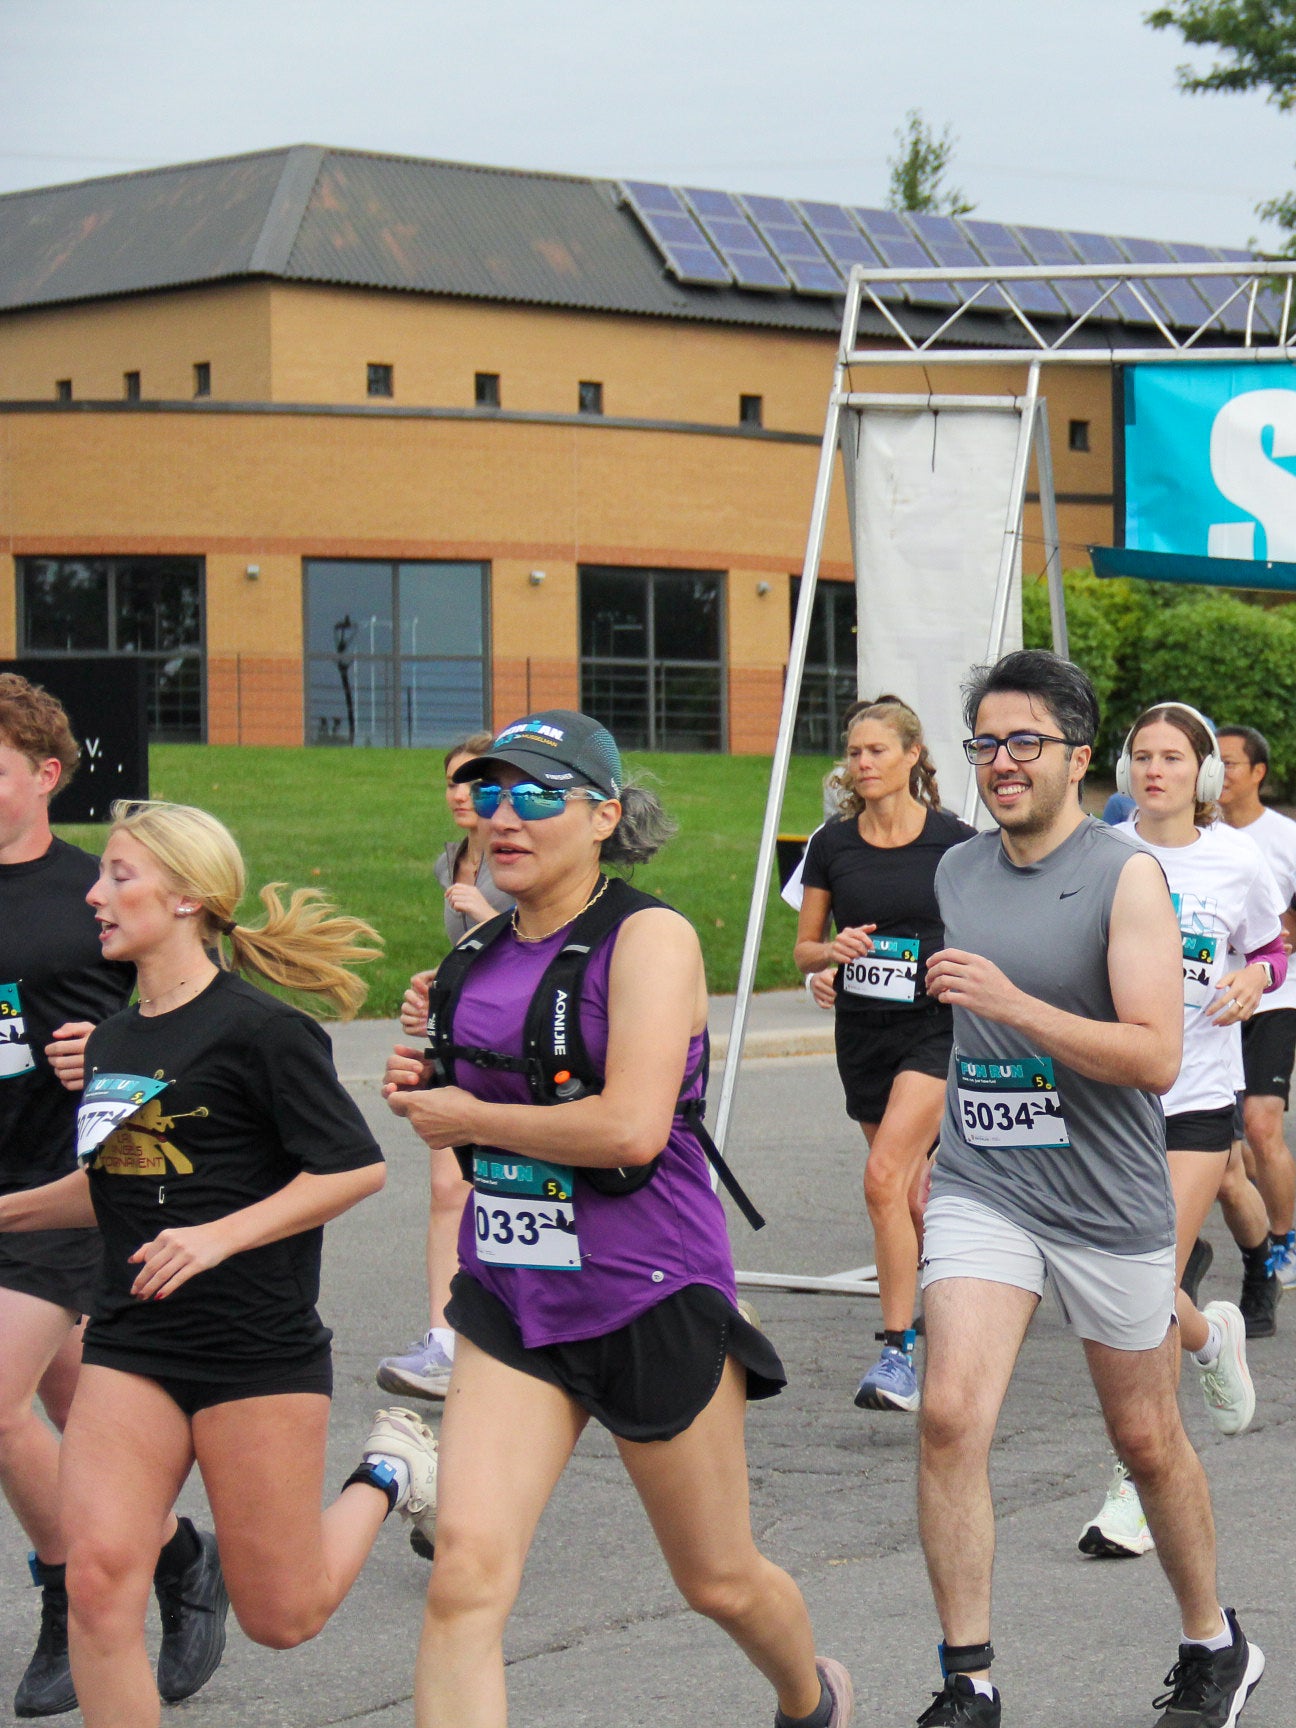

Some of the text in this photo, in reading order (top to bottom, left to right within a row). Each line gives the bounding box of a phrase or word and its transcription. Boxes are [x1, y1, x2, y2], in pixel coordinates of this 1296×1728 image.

[846, 963, 895, 987] 5067
[554, 989, 568, 1056] AONIJIE
[961, 1062, 1024, 1079] FUN RUN
[1036, 1076, 1044, 1087] 5
[963, 1100, 1034, 1131] 5034
[491, 1162, 533, 1181] RUN
[547, 1183, 557, 1195] 5
[476, 1205, 540, 1246] 033
